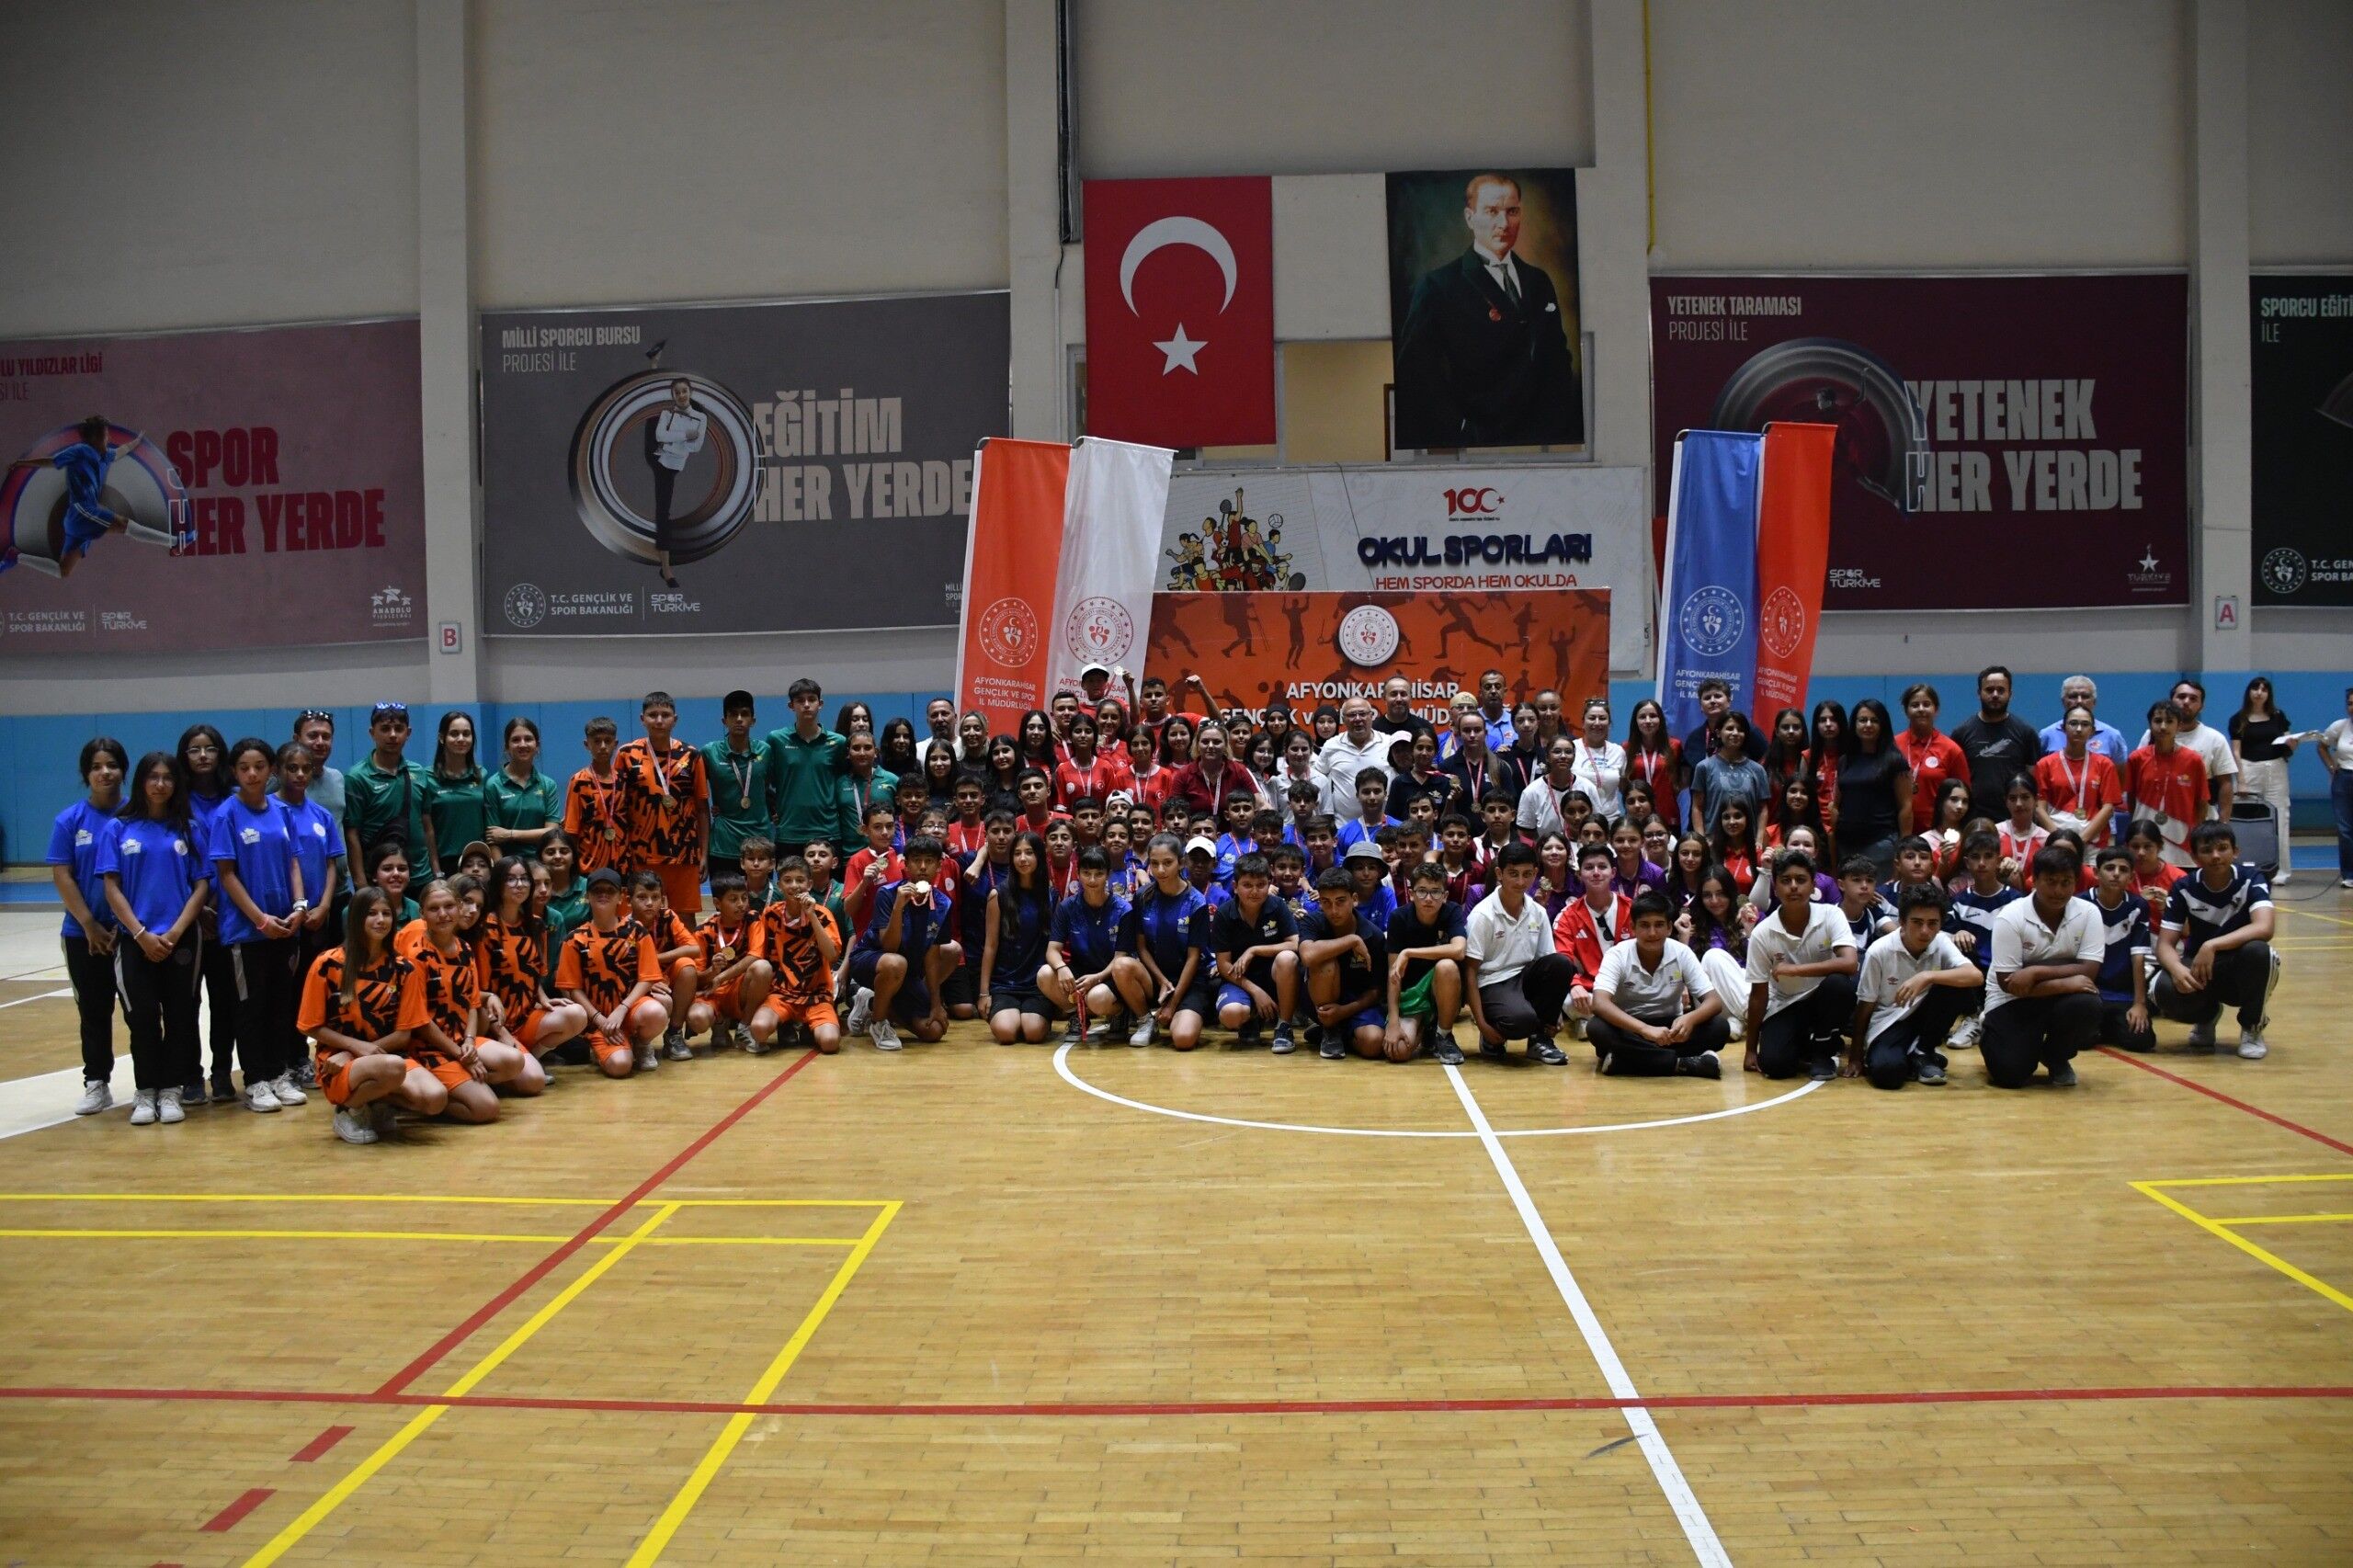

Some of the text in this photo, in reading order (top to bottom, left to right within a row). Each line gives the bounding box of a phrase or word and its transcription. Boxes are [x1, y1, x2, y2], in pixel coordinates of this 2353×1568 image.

[1667, 296, 1802, 316] YETENEK TARAMASI
[2261, 298, 2317, 317] SPORCU
[502, 325, 641, 348] MİLLİ SPORCU BURSU
[1669, 319, 1748, 341] PROJESİ İLE
[2261, 320, 2279, 343] İLE
[503, 350, 555, 372] PROJESİ
[1904, 379, 2097, 442] YETENEK
[753, 388, 902, 457] EĞİTİM
[166, 427, 279, 489] SPOR
[754, 459, 972, 523] HER YERDE
[1906, 449, 2143, 513] HER YERDE
[169, 489, 385, 557] HER YERDE
[1357, 533, 1592, 567] OKUL SPORLARI
[2311, 560, 2331, 569] T.C.
[1376, 574, 1577, 590] HEM SPORDA HEM OKULDA
[2311, 572, 2340, 582] SPOR
[551, 592, 633, 606] T.C. GENÇLİK VE
[28, 610, 70, 622] GENÇLİK
[73, 610, 85, 620] VE
[551, 604, 633, 615] SPOR BAKANLIĞI
[2220, 604, 2234, 623] A
[9, 621, 85, 633] SPOR BAKANLIĞI
[443, 628, 457, 647] B
[1011, 690, 1020, 699] VE
